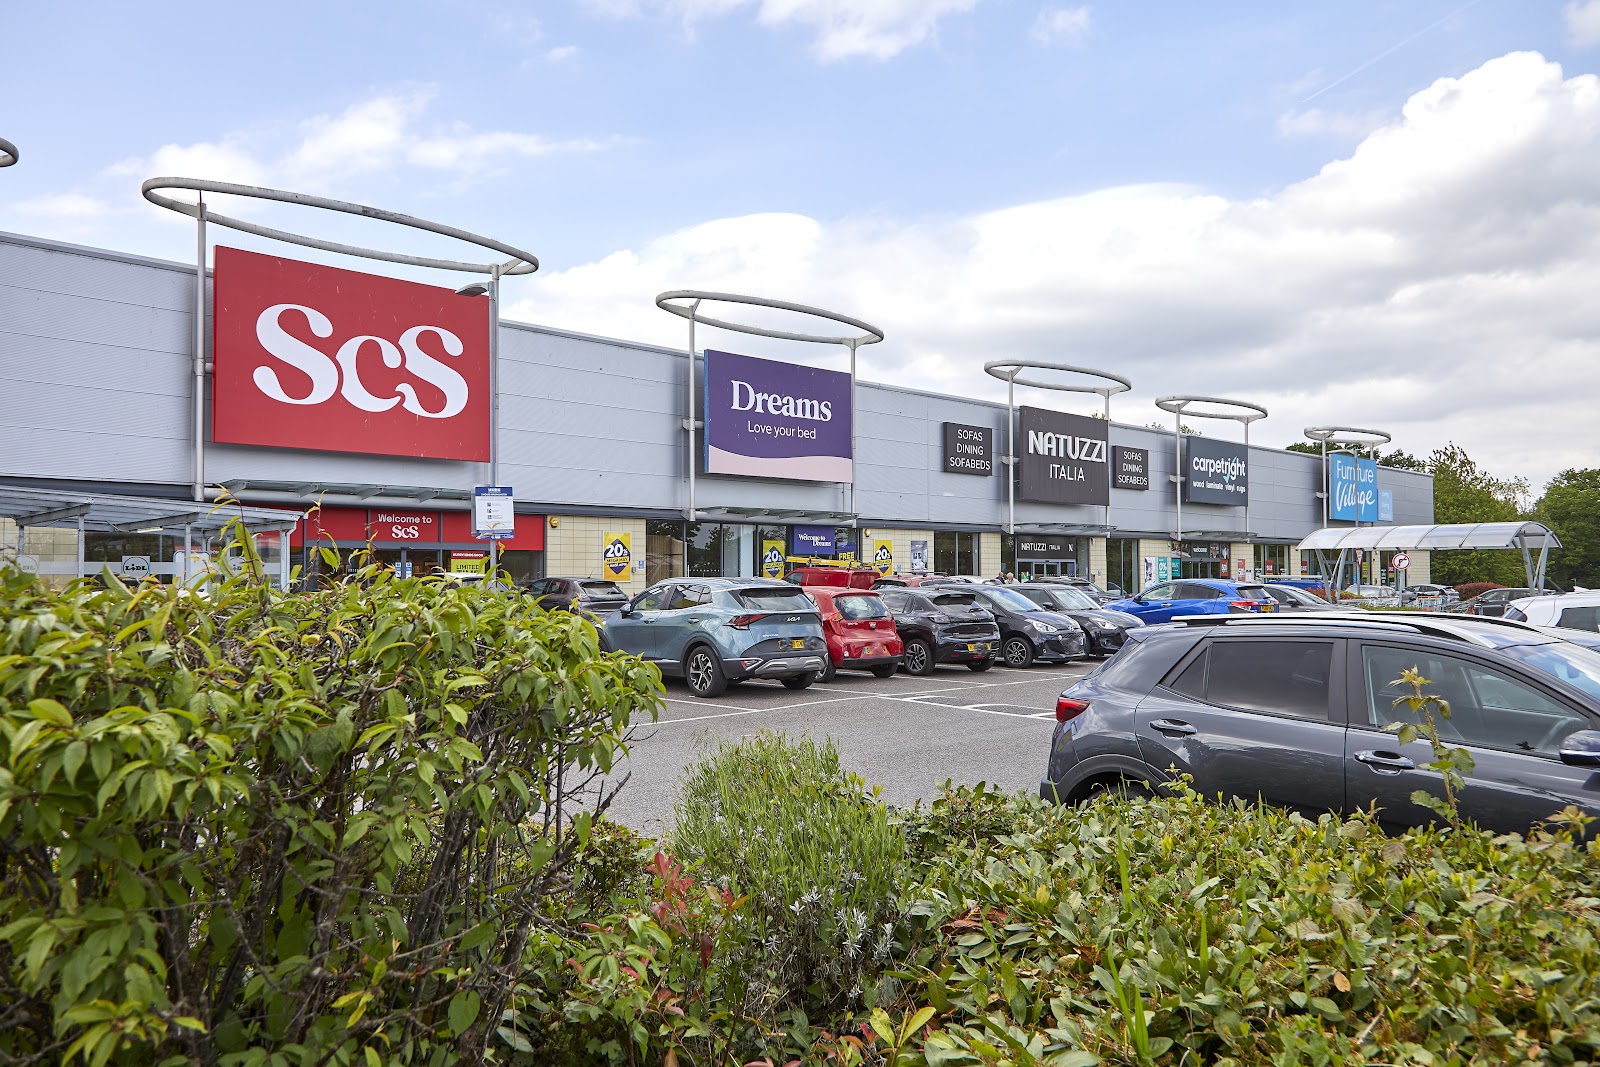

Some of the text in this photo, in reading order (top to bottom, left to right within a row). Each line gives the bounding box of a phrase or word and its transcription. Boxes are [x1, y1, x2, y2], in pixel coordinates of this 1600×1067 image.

[252, 303, 469, 419] ScS
[730, 380, 832, 422] Dreams
[747, 420, 817, 440] Love your bed
[957, 429, 983, 442] SOFAS
[956, 443, 984, 456] DINING
[1028, 430, 1107, 463] NATUZZI
[1123, 451, 1142, 462] SOFAS
[949, 457, 991, 471] SOFABEDS
[1122, 463, 1143, 473] DINING
[1192, 456, 1246, 480] carpetright
[1049, 463, 1085, 482] ITALIA
[1336, 460, 1374, 483] Furnture
[1117, 474, 1148, 486] SOFABEDS
[1192, 480, 1246, 494] wood laminate vinyl rugs
[378, 513, 433, 524] Welcome to
[391, 525, 420, 539] ScS
[798, 532, 820, 541] Welcome
[1021, 542, 1047, 551] NATUZZI
[838, 551, 855, 561] FREE
